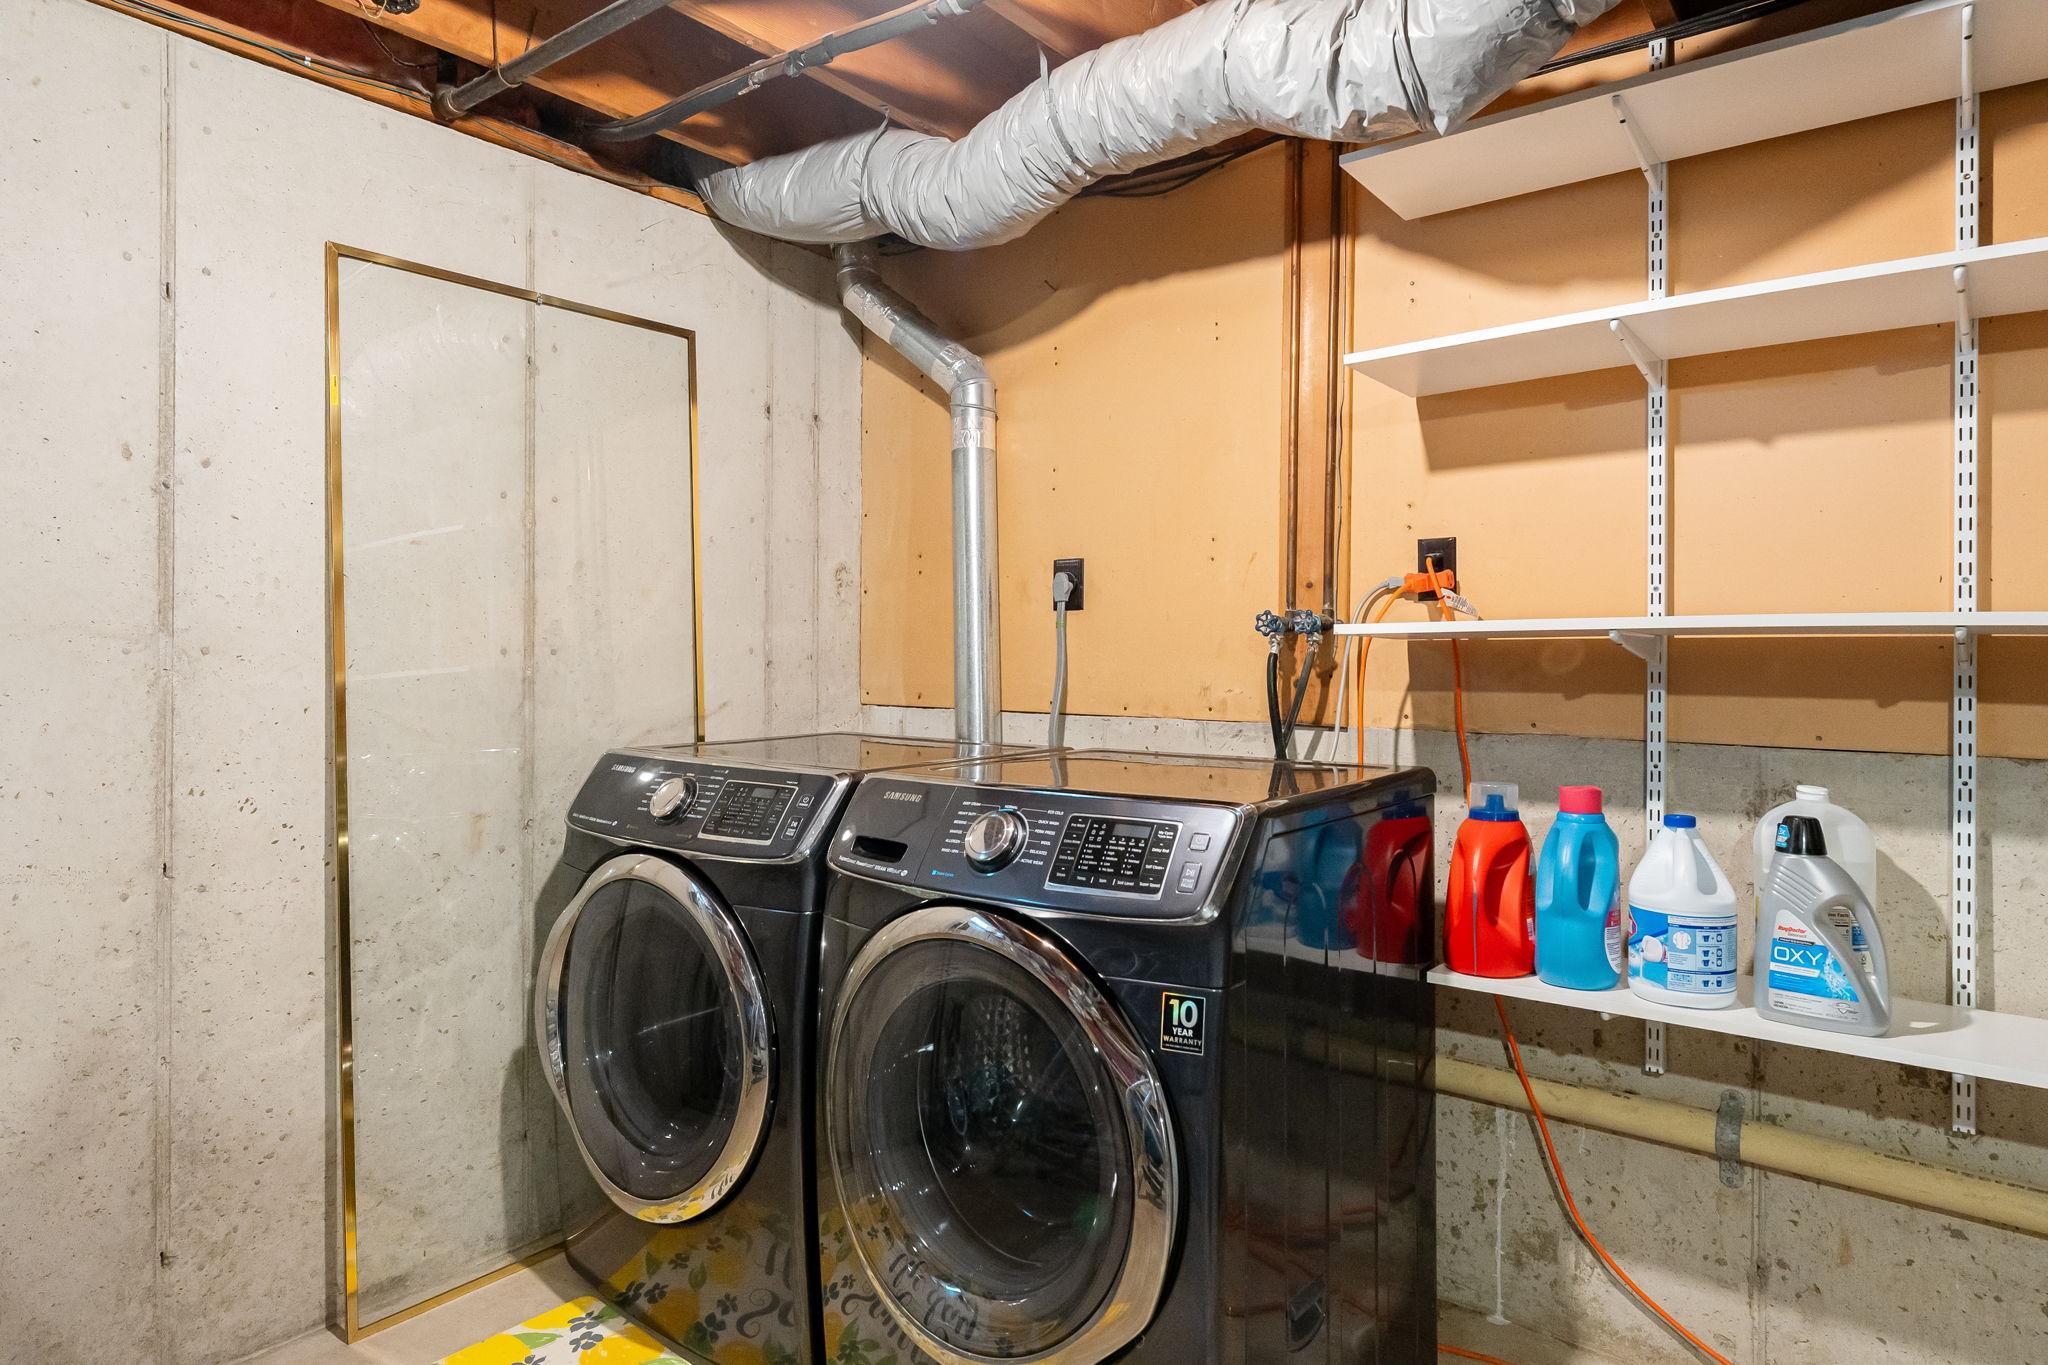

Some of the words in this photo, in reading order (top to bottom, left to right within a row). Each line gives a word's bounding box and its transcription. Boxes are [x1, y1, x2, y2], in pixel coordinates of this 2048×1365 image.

[884, 791, 923, 803] SAMSUNG
[1774, 946, 1823, 966] OXY
[1169, 998, 1198, 1028] 10
[1172, 1027, 1193, 1037] YEAR
[1163, 1035, 1202, 1046] WARRANTY
